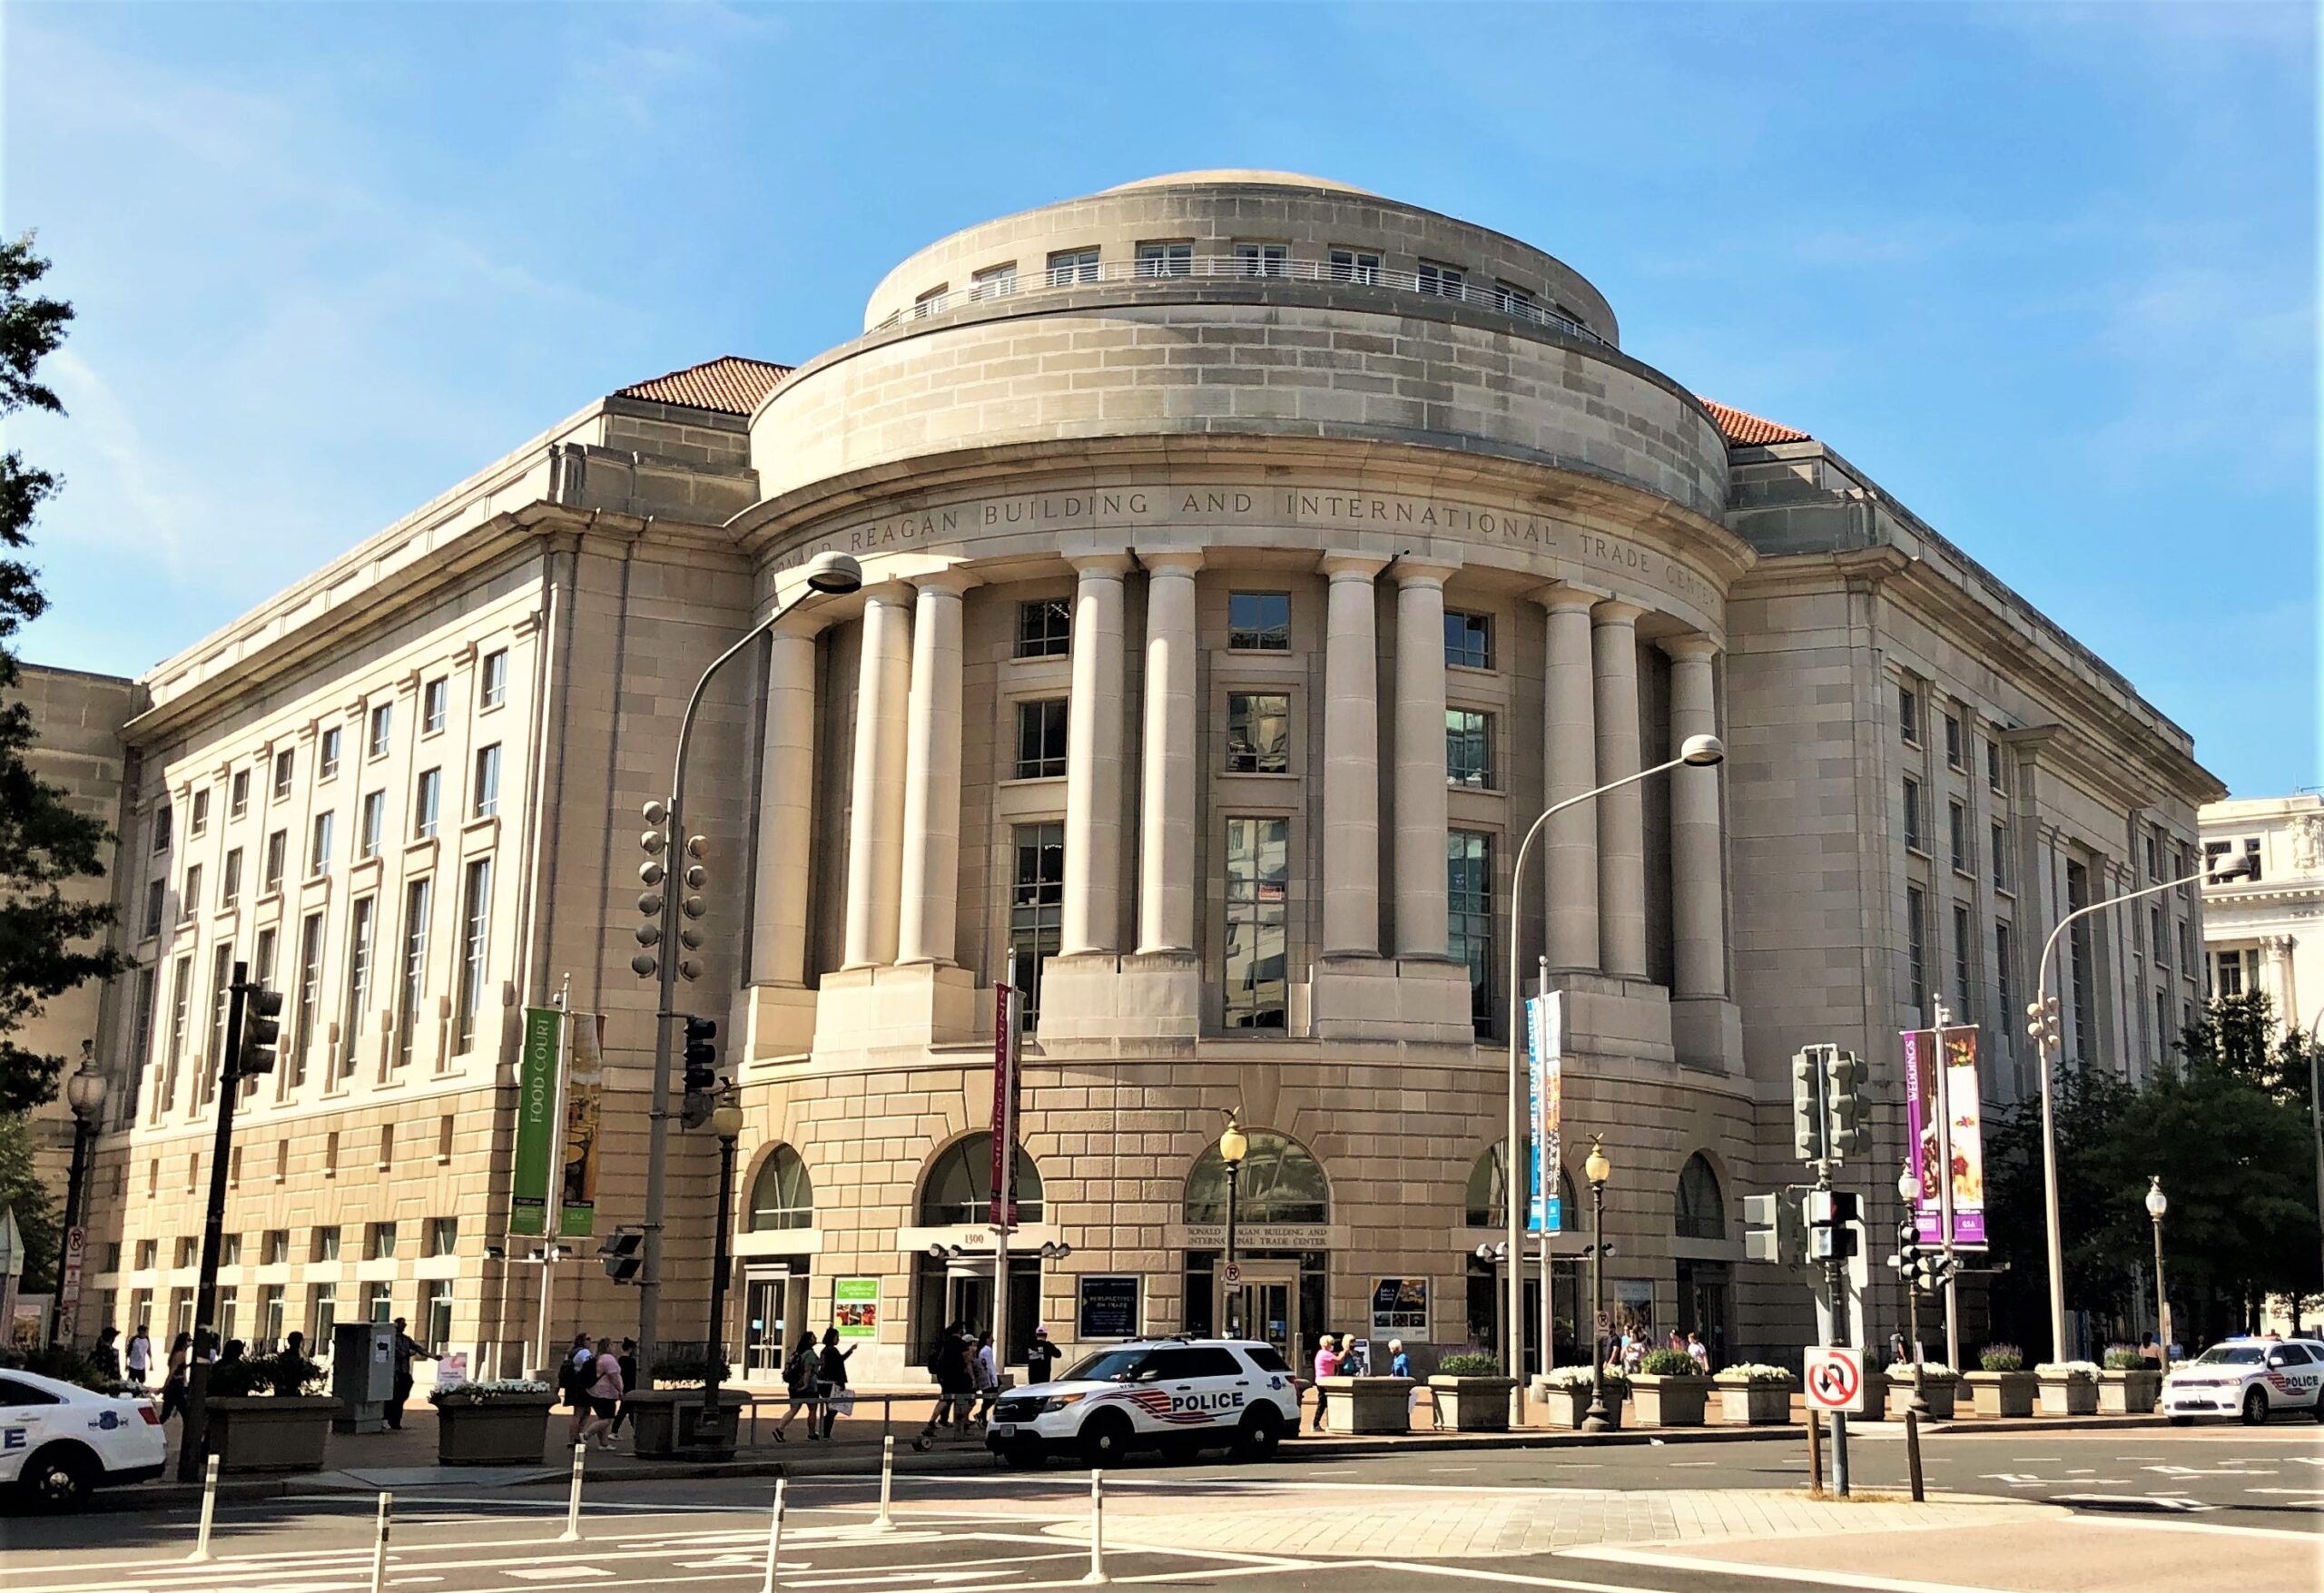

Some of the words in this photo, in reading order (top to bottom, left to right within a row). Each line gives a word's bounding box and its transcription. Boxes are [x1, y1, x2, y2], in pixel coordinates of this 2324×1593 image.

[851, 511, 959, 552] REAGAN
[984, 493, 1147, 526] BUILDING
[1181, 493, 1252, 514] AND
[1285, 494, 1558, 546] INTERNATIONAL
[1579, 534, 1649, 574] TRADE
[1665, 565, 1718, 605] CENTER
[533, 1018, 549, 1072] COURT
[1528, 1009, 1536, 1057] CENTER
[1530, 1059, 1538, 1097] TRADE
[1905, 1039, 1918, 1102] WEDDINGS
[529, 1077, 546, 1123] FOOD
[994, 1077, 1004, 1168] MEETINGS
[1531, 1101, 1539, 1146] WORLD
[1187, 1227, 1222, 1235] RONALD
[1264, 1228, 1304, 1236] BUILDING
[1307, 1228, 1327, 1236] AND
[1187, 1236, 1256, 1244] INTERNAONAL
[1259, 1237, 1289, 1245] TRADE
[1293, 1237, 1327, 1245] CENTER
[1172, 1391, 1245, 1412] POLICE
[2285, 1375, 2319, 1388] POLICE
